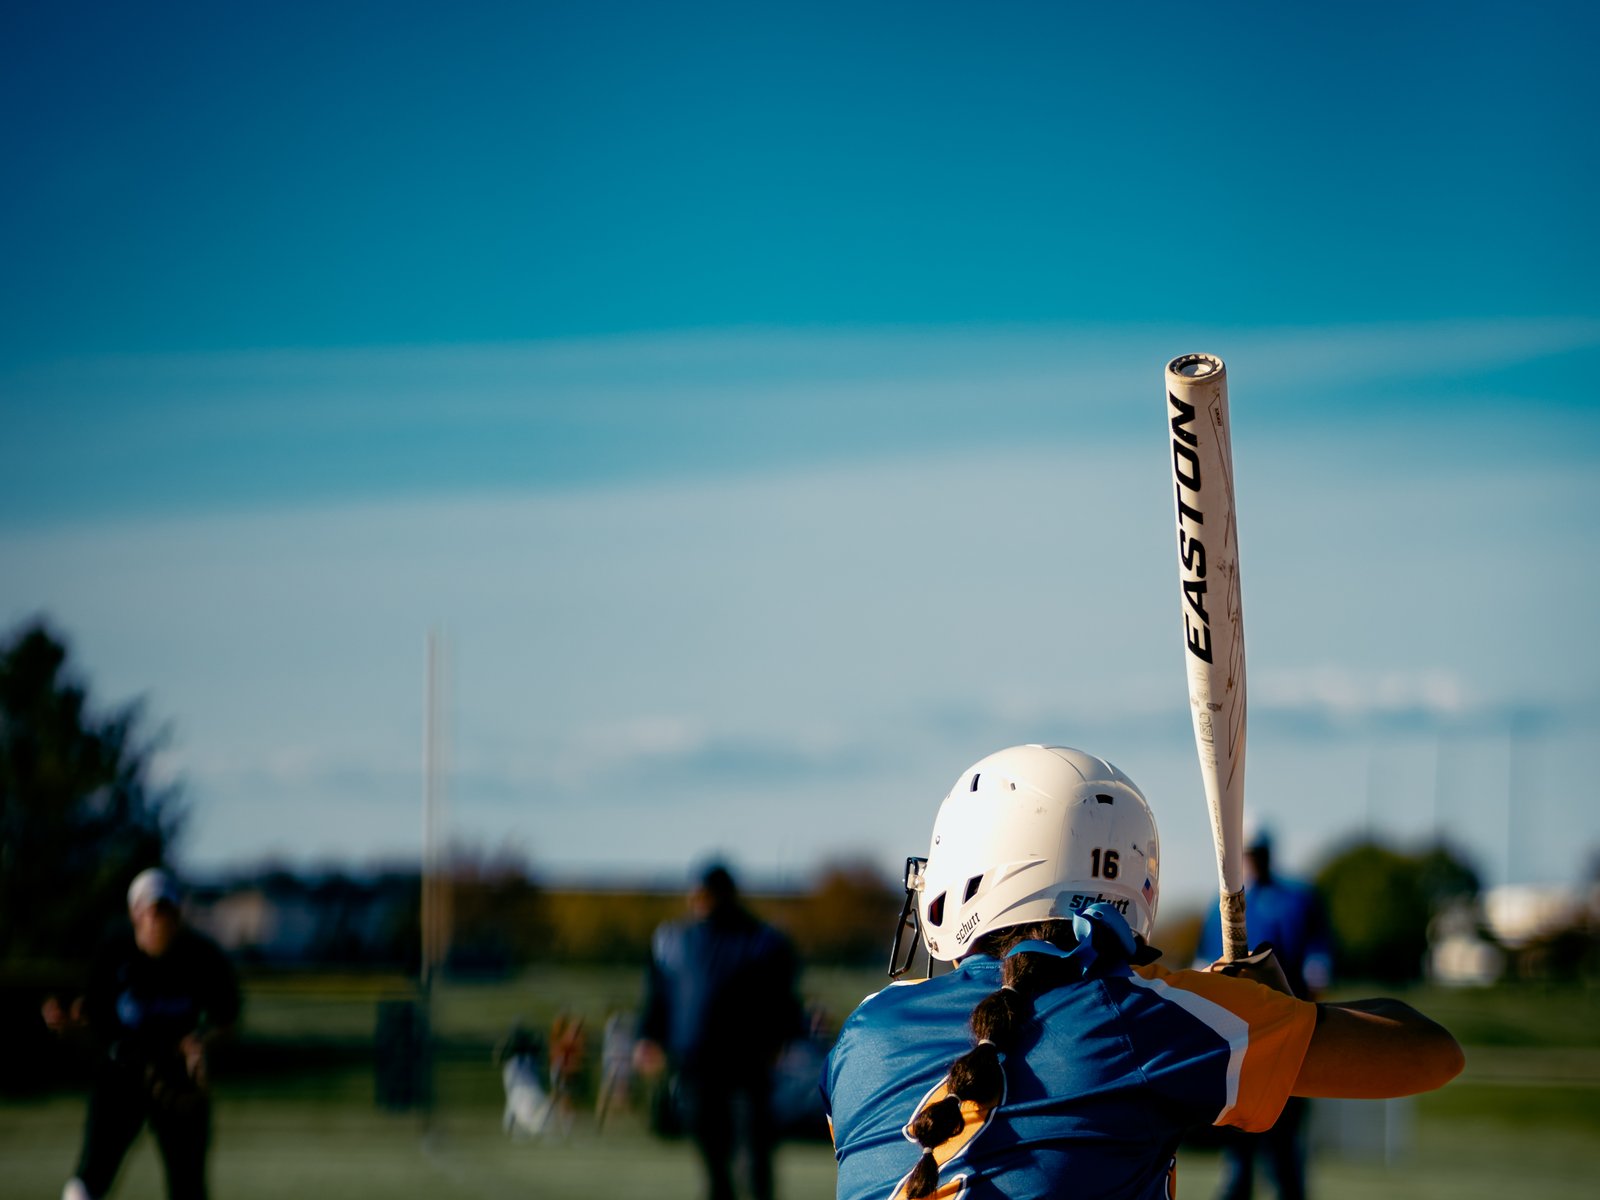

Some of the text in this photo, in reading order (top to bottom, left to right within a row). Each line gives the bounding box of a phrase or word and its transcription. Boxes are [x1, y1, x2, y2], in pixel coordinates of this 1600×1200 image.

[1168, 390, 1213, 665] EASTON
[1091, 848, 1120, 880] 16
[1069, 893, 1130, 915] sctt
[955, 912, 981, 945] schutt
